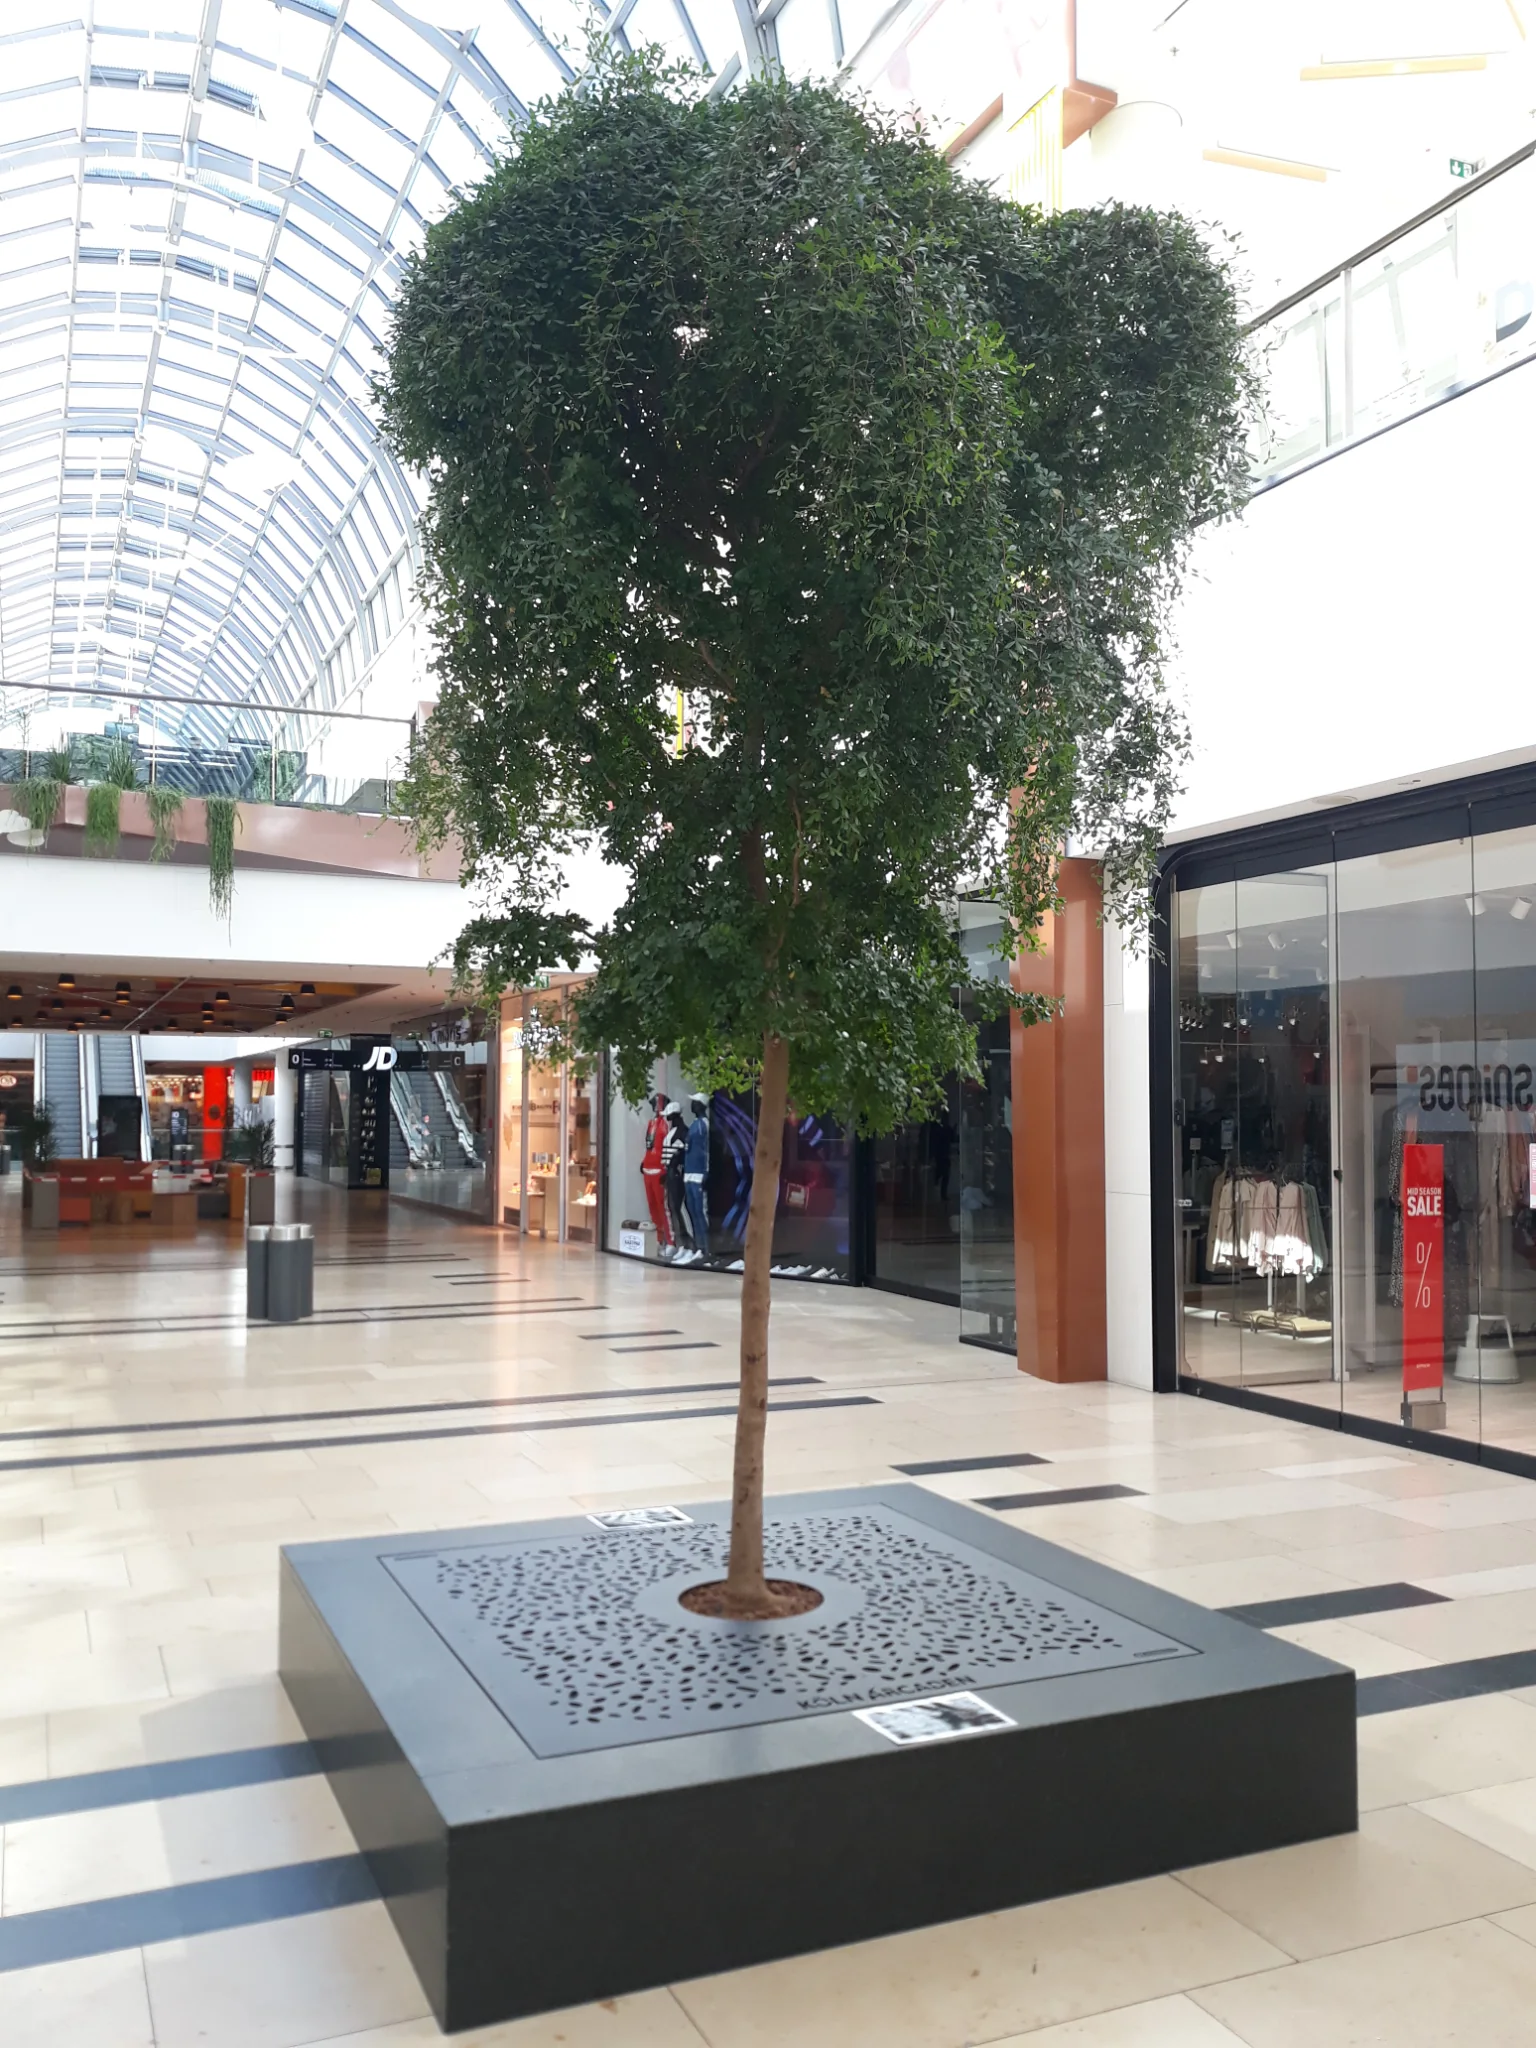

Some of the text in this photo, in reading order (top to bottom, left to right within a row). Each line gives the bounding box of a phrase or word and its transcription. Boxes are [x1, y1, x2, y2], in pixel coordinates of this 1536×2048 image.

[362, 1046, 398, 1071] JD
[1407, 1186, 1442, 1196] MID SEASON
[1407, 1195, 1442, 1217] SALE
[1415, 1242, 1432, 1308] %
